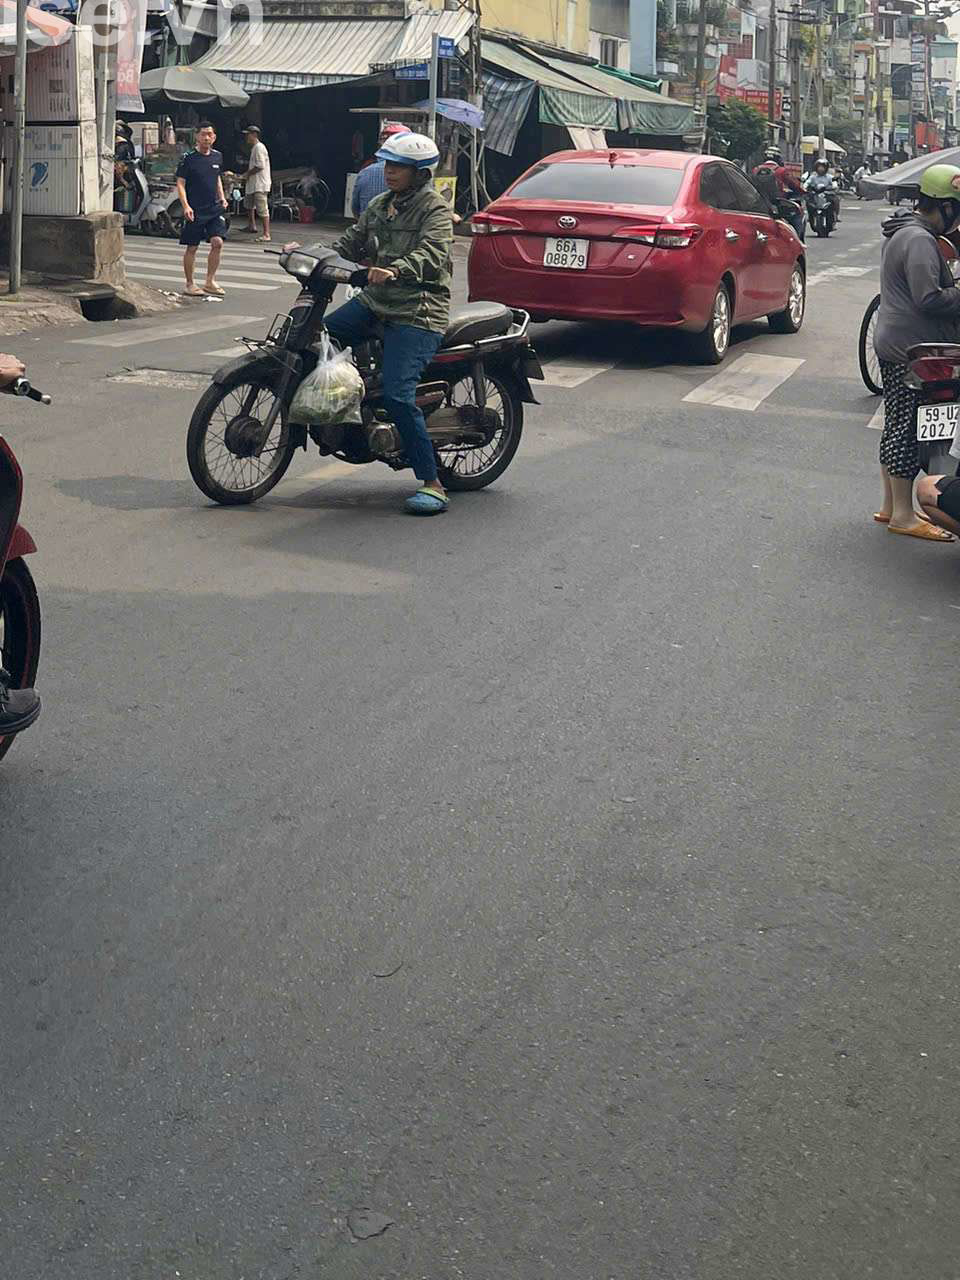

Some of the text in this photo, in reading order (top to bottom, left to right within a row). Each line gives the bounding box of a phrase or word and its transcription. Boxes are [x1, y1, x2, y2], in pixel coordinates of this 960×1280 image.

[555, 240, 577, 253] 66A
[925, 406, 960, 422] 59-U2
[920, 421, 957, 439] 202.7
